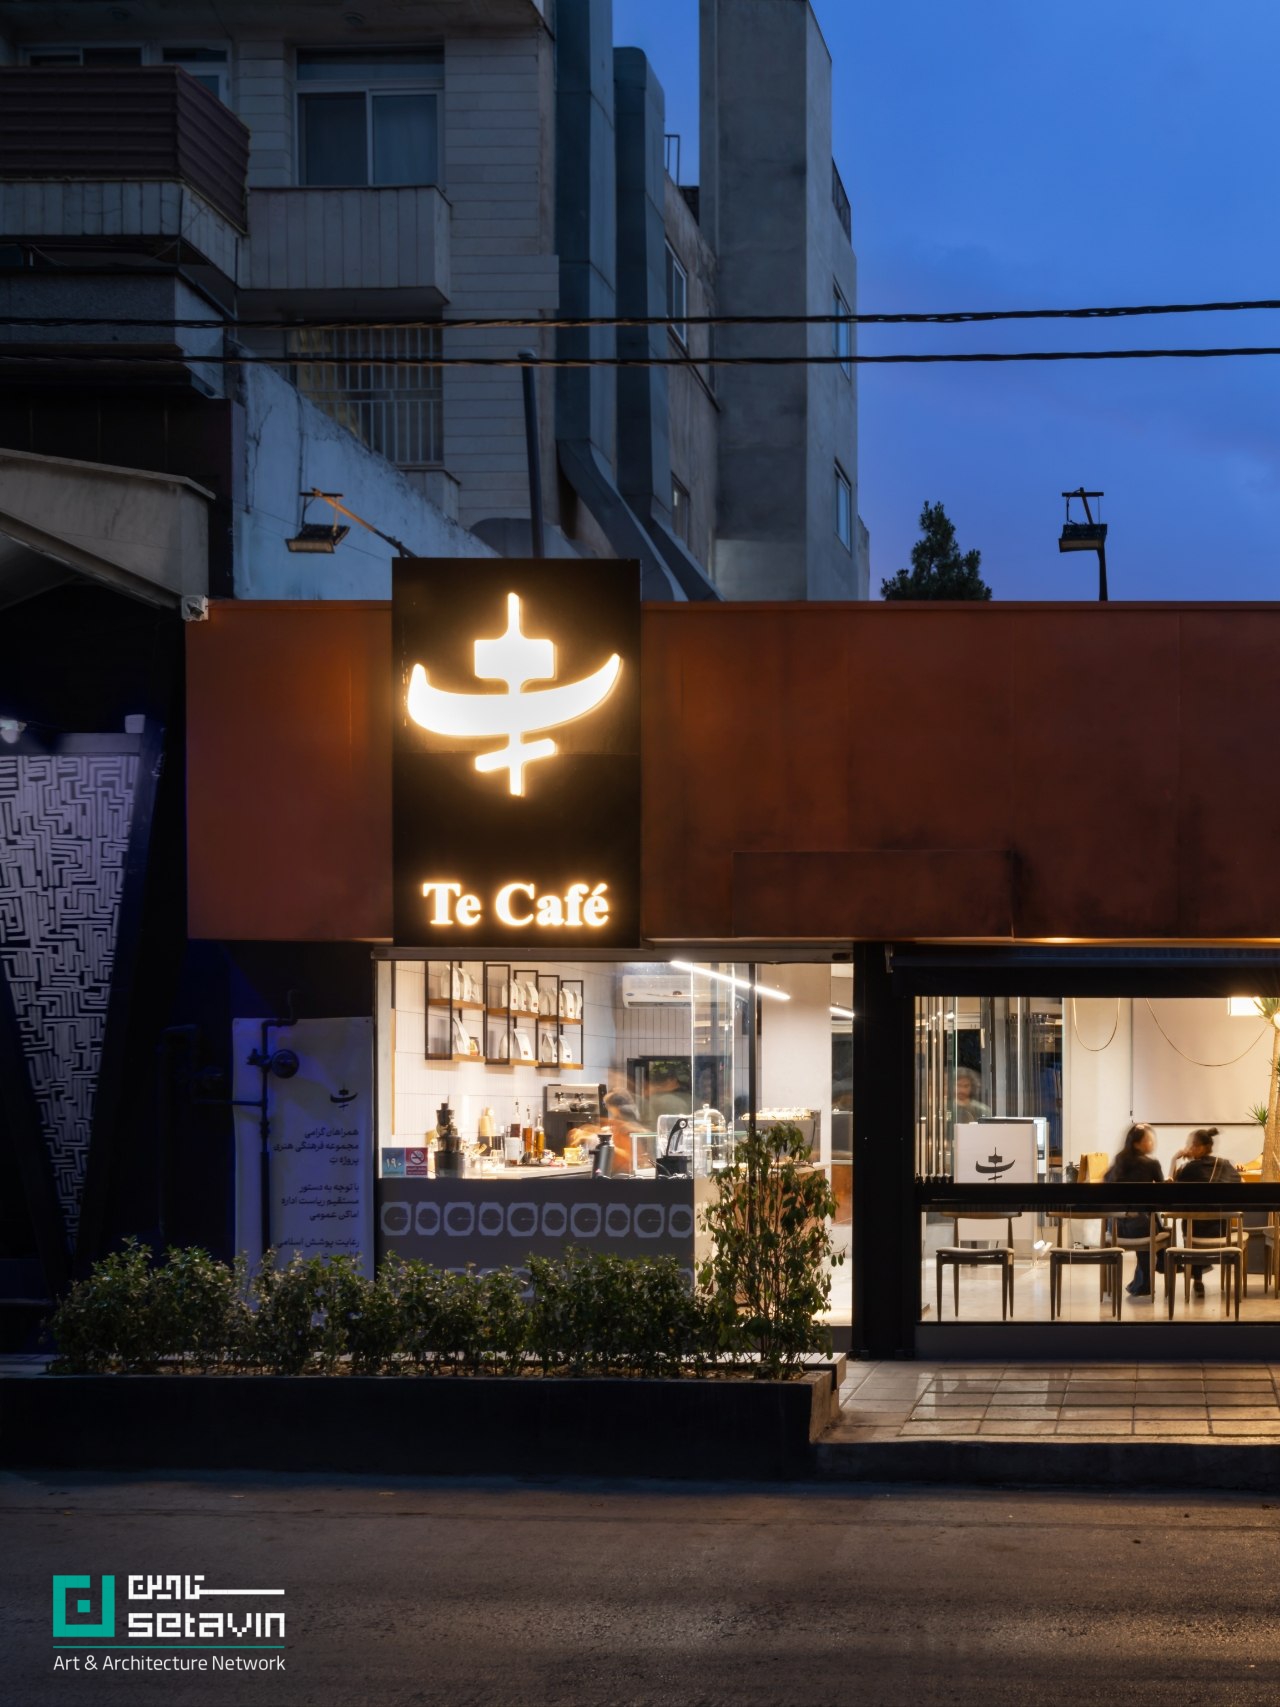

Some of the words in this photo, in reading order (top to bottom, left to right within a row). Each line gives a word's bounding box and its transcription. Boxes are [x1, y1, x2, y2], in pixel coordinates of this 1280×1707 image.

[422, 882, 481, 926] Te
[495, 882, 610, 926] Café
[304, 1127, 326, 1138] گرامی
[273, 1142, 294, 1152] هنری
[295, 1141, 324, 1152] فرهنگی
[326, 1142, 359, 1152] مجموعه
[340, 1156, 359, 1166] پروژه
[299, 1183, 323, 1193] دستور
[324, 1184, 332, 1192] به
[333, 1183, 353, 1193] توجه
[353, 1183, 359, 1193] با
[281, 1196, 298, 1206] اداره
[326, 1196, 359, 1206] مستقیم
[309, 1211, 337, 1221] عمومی
[338, 1210, 359, 1220] اماکن
[276, 1237, 304, 1249] اسلامی
[305, 1237, 334, 1248] پوشش
[335, 1238, 360, 1248] رعایت
